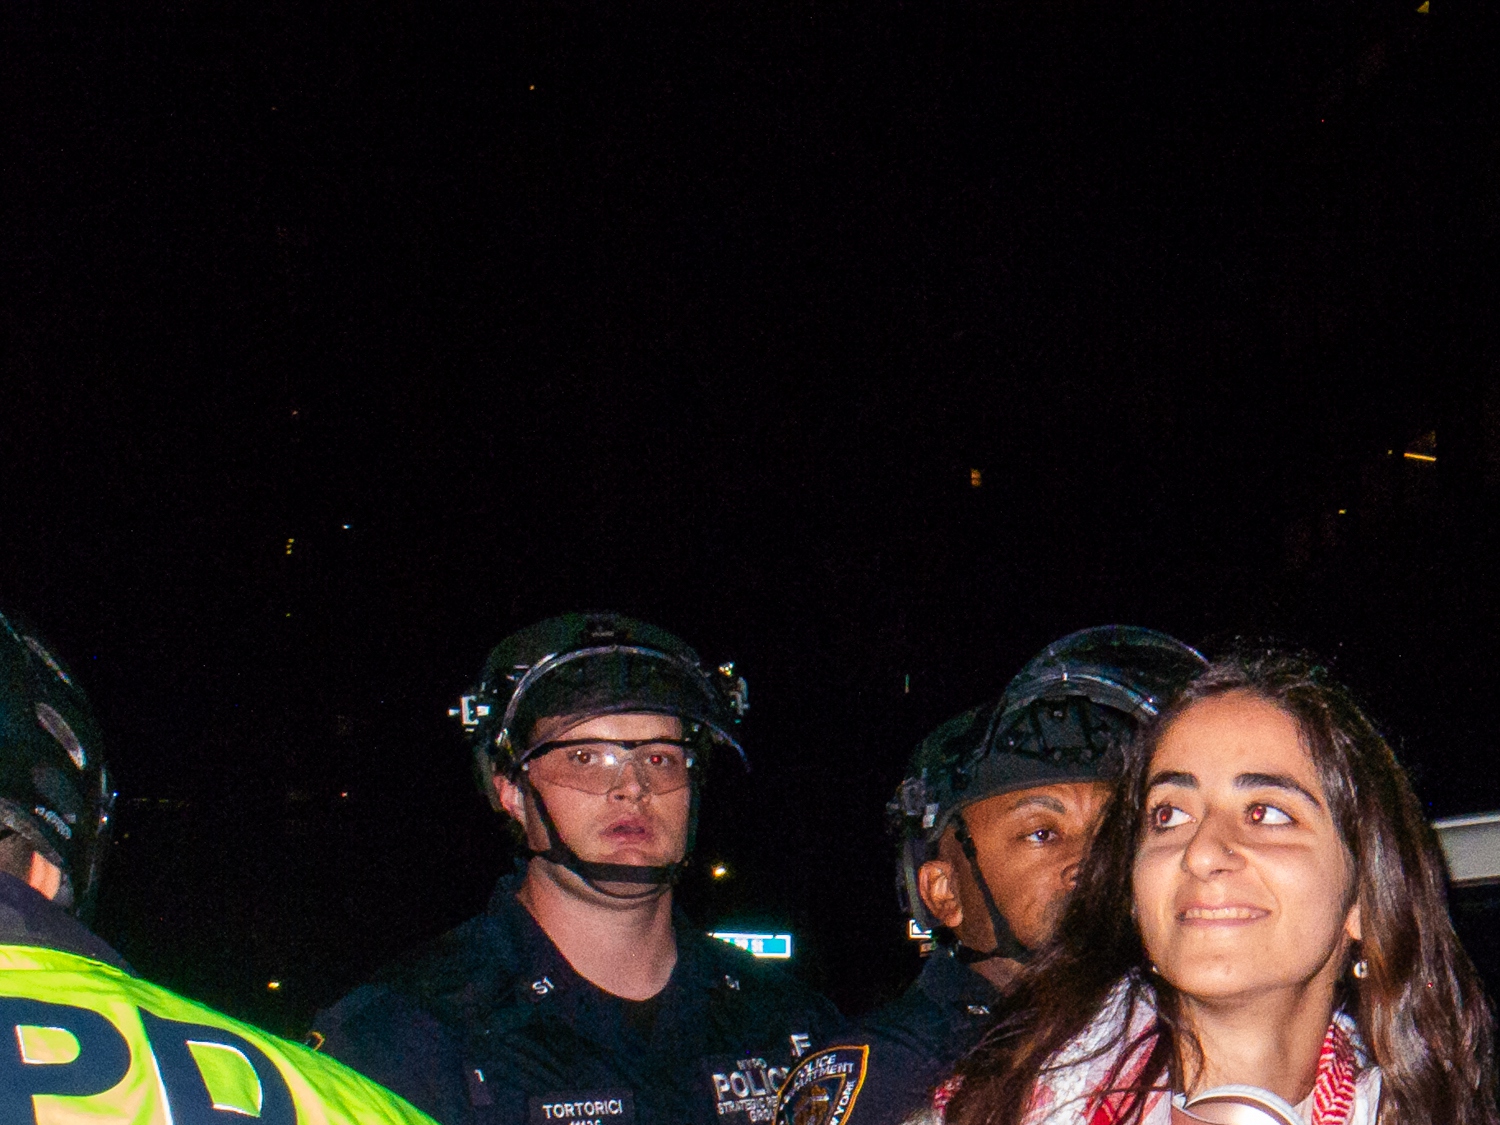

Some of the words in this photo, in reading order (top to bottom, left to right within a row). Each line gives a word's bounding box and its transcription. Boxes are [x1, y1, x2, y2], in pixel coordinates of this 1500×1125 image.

[531, 976, 555, 995] S1
[712, 1066, 790, 1101] POLIC
[542, 1099, 623, 1119] TORTORICI
